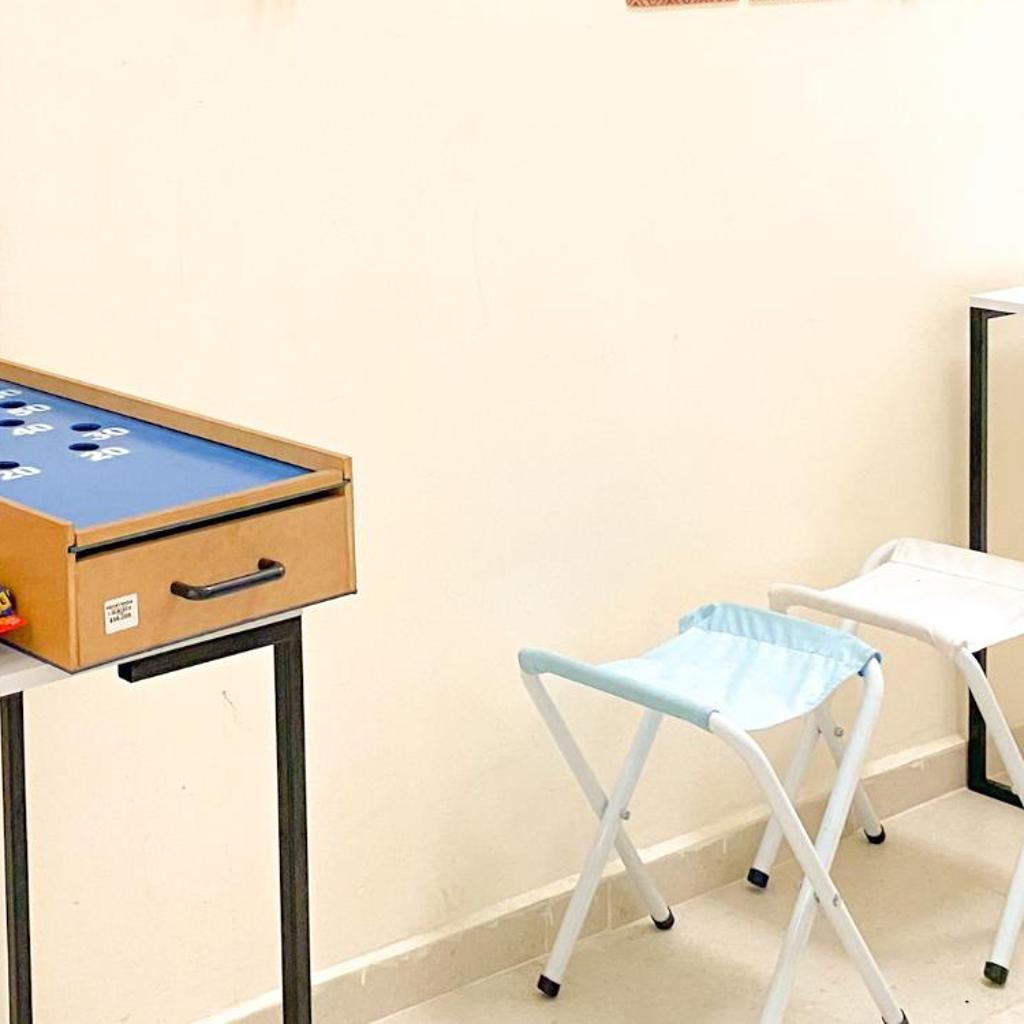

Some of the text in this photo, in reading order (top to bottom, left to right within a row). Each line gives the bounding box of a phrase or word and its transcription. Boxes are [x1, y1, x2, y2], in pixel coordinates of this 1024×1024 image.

[7, 403, 52, 417] 50
[12, 423, 55, 436] 40
[82, 427, 131, 441] 30
[80, 447, 131, 462] 20
